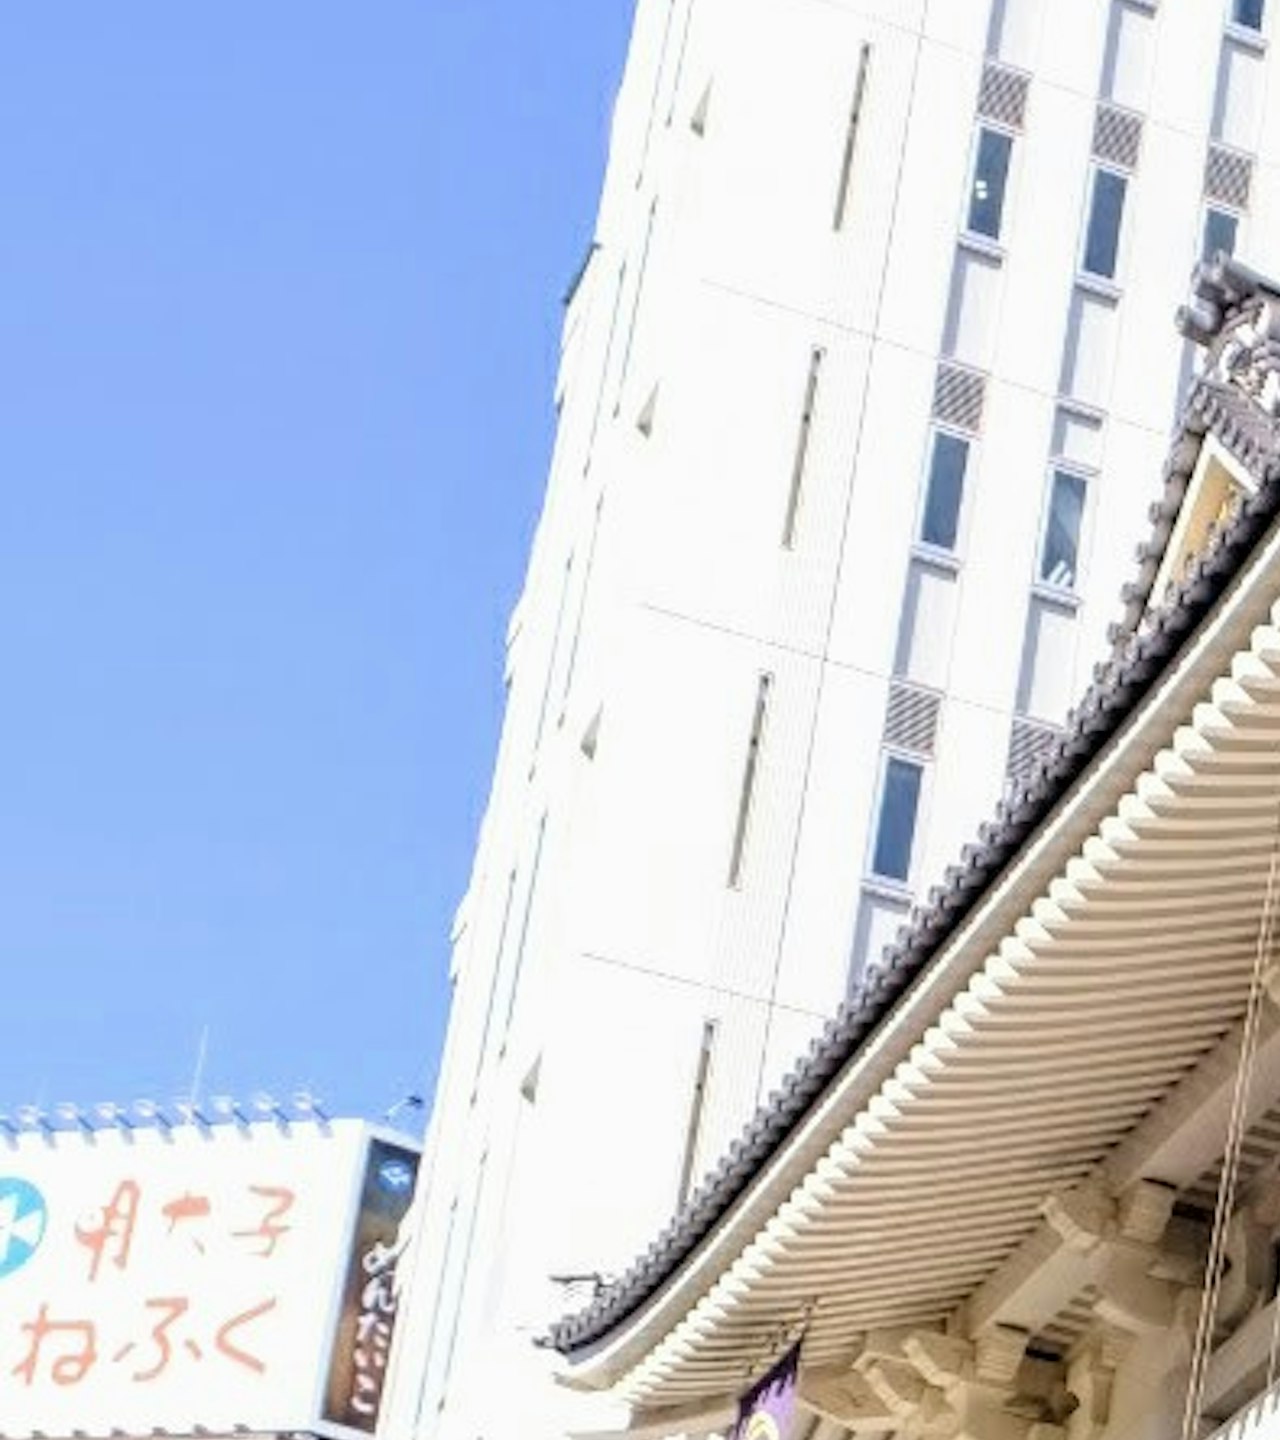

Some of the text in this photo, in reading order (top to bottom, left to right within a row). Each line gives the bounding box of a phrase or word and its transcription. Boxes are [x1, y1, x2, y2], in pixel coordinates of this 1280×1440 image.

[73, 1178, 298, 1282] 明太子
[11, 1294, 279, 1387] ねふく
